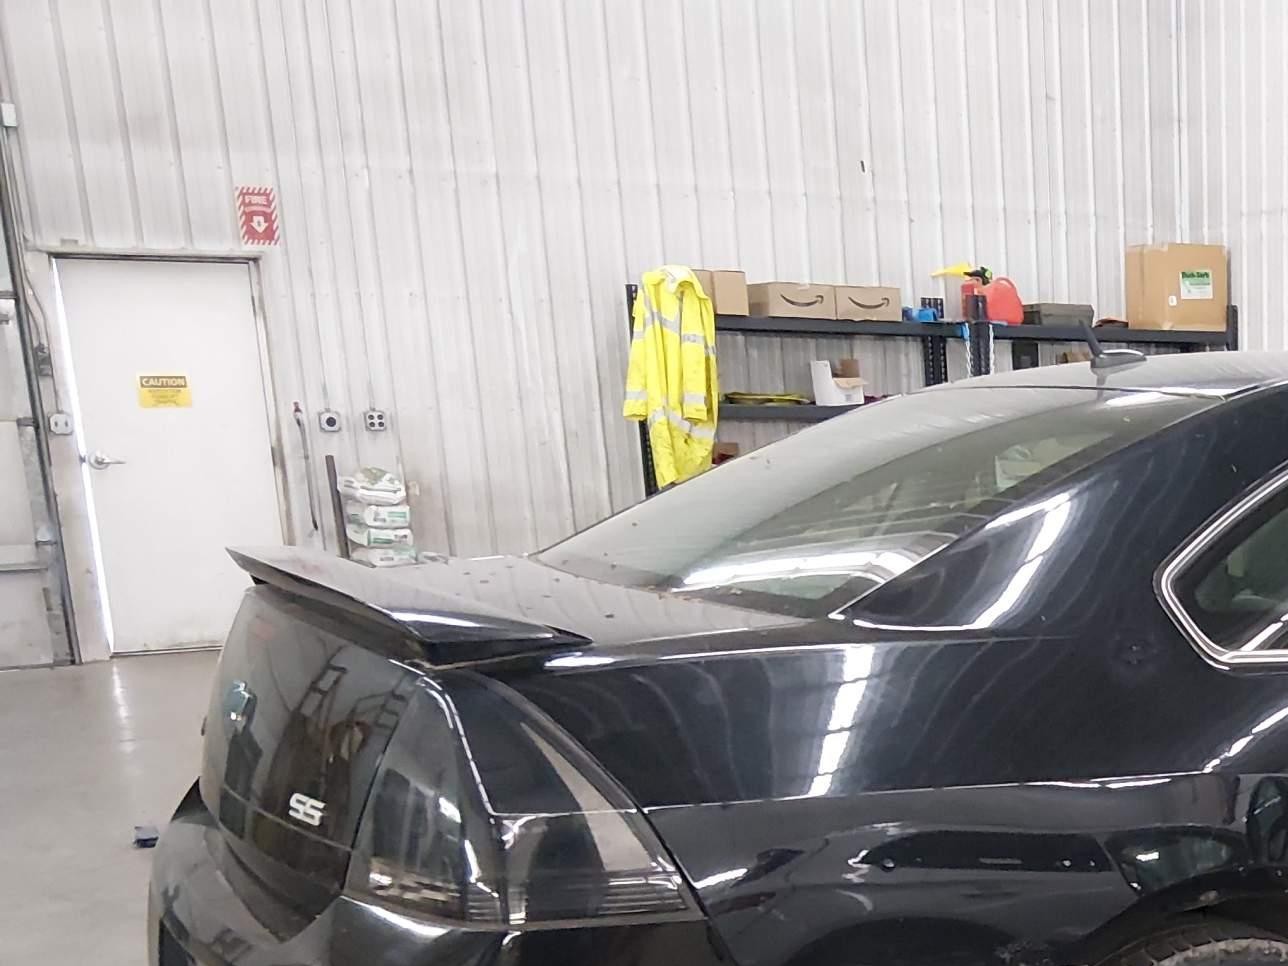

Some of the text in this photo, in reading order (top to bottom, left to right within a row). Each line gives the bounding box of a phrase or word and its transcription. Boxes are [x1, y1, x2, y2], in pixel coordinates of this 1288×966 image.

[244, 194, 269, 205] FIRE
[142, 378, 186, 387] CAUTION
[288, 792, 327, 827] SS
